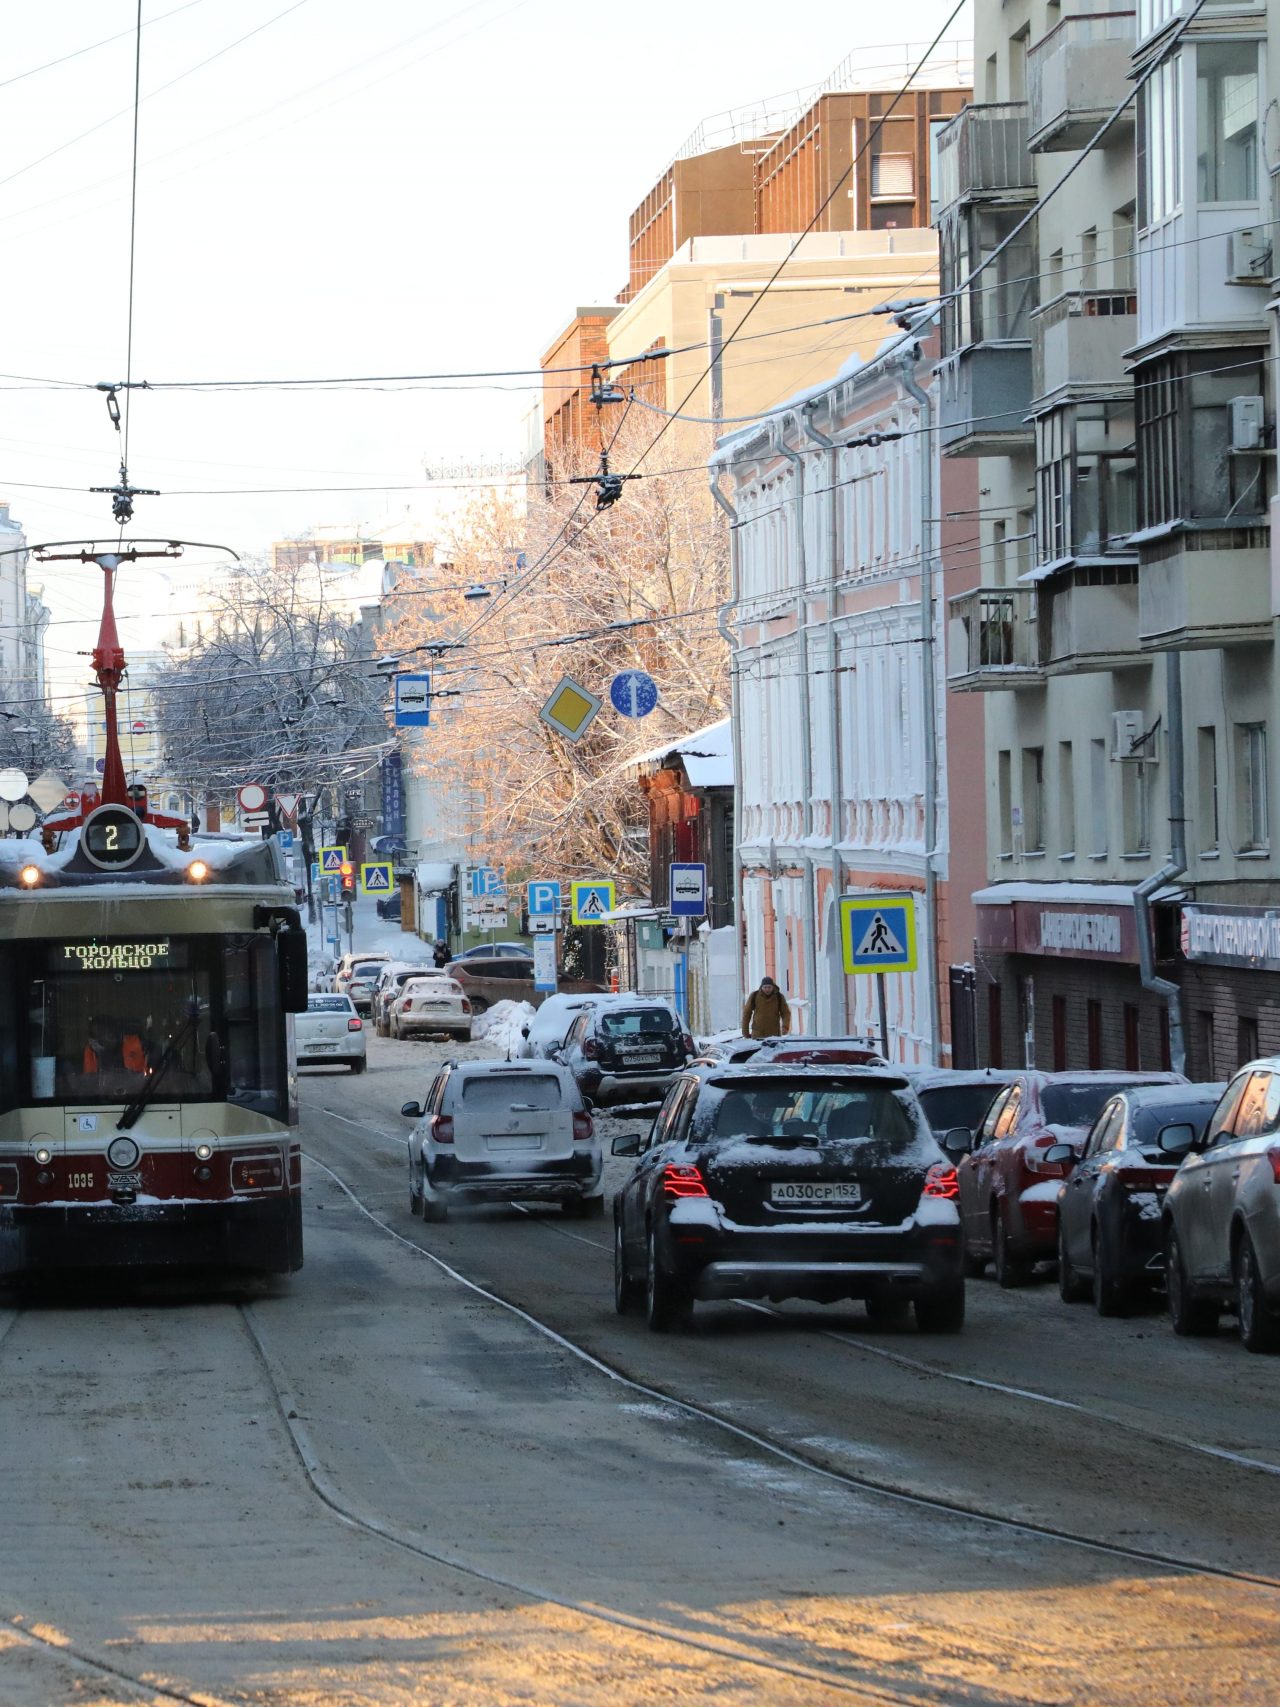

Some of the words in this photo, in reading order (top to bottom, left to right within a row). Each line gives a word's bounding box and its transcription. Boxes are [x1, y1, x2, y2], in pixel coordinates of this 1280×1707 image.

[105, 825, 119, 850] 2
[280, 833, 289, 846] P
[345, 878, 352, 887] 6
[535, 886, 554, 912] P
[64, 944, 169, 957] ГОРОДСКОЕ
[82, 955, 152, 969] КОЛЬЦО
[68, 1173, 94, 1188] 1035
